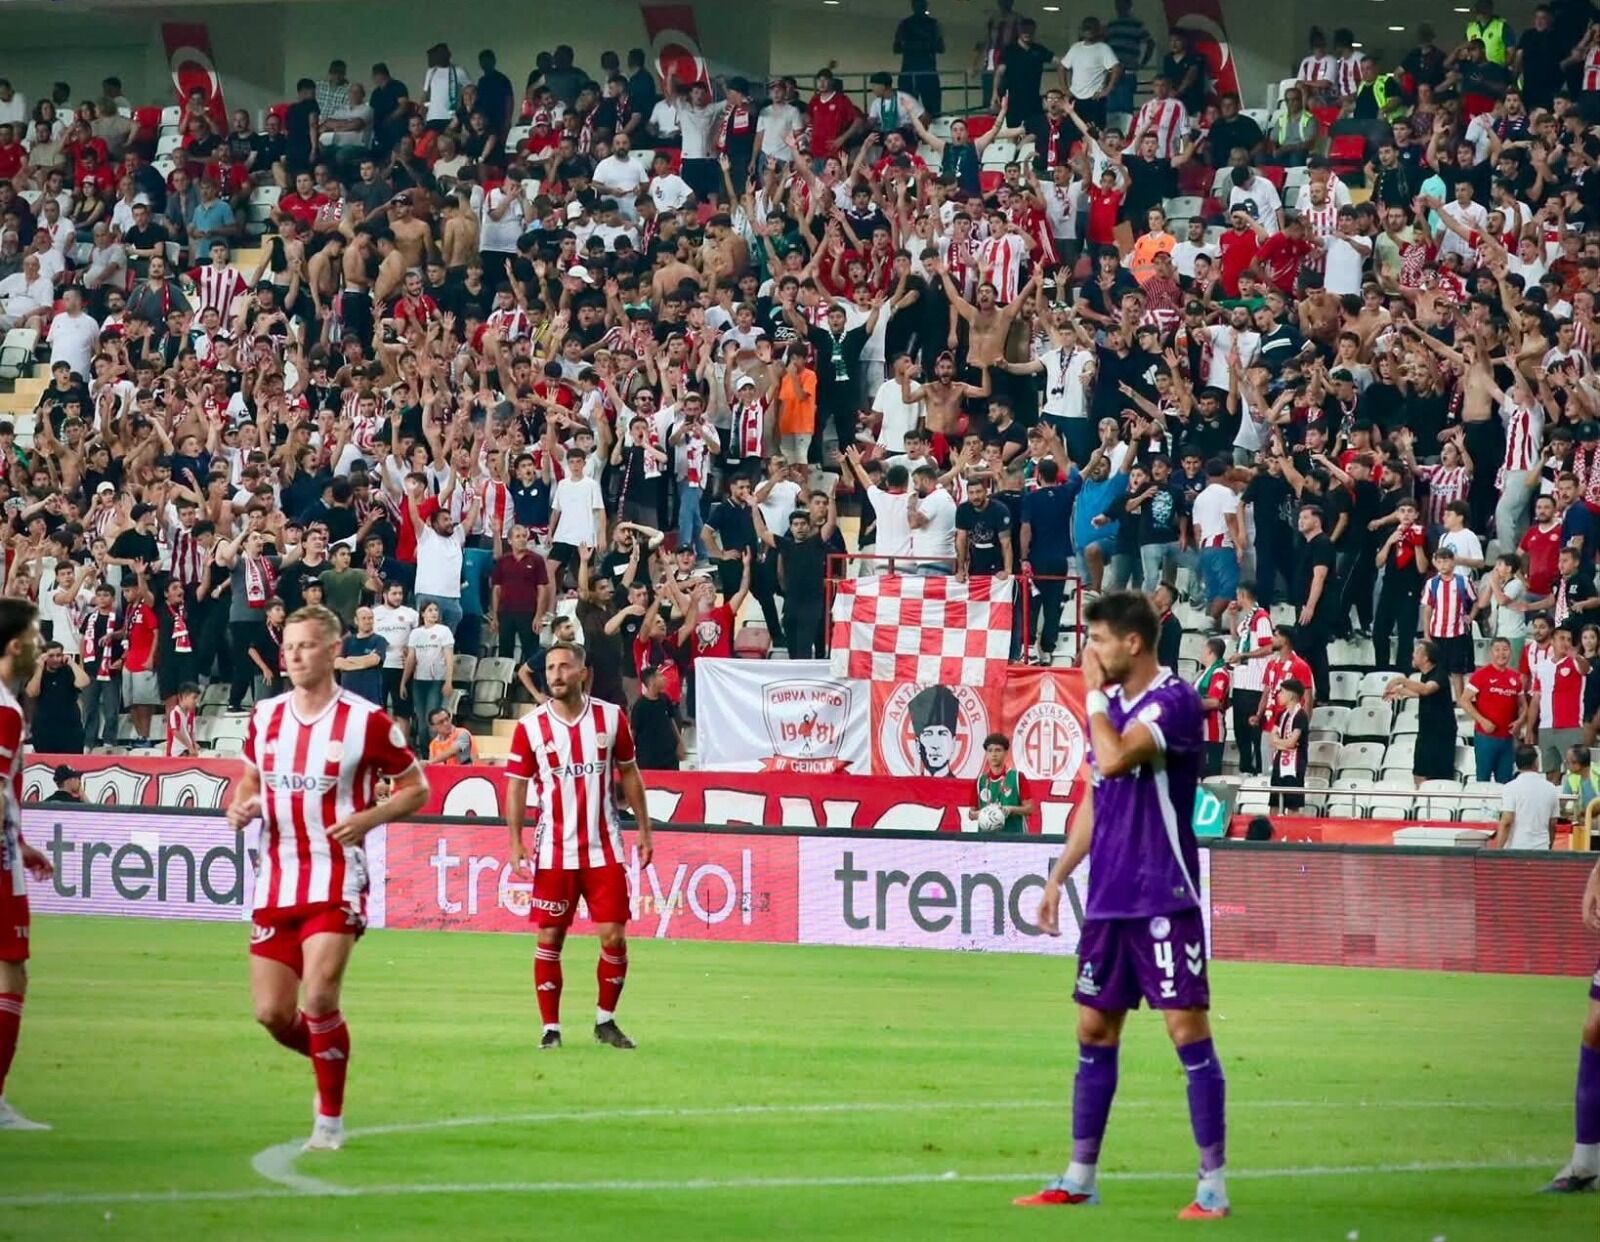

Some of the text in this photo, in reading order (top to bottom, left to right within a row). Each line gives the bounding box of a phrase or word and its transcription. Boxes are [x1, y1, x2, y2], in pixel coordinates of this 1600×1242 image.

[771, 689, 843, 707] CURVA NORD
[1017, 704, 1080, 738] ANTALYASPOR
[565, 763, 594, 777] ADO
[280, 774, 317, 790] ADO
[1153, 941, 1175, 978] 4
